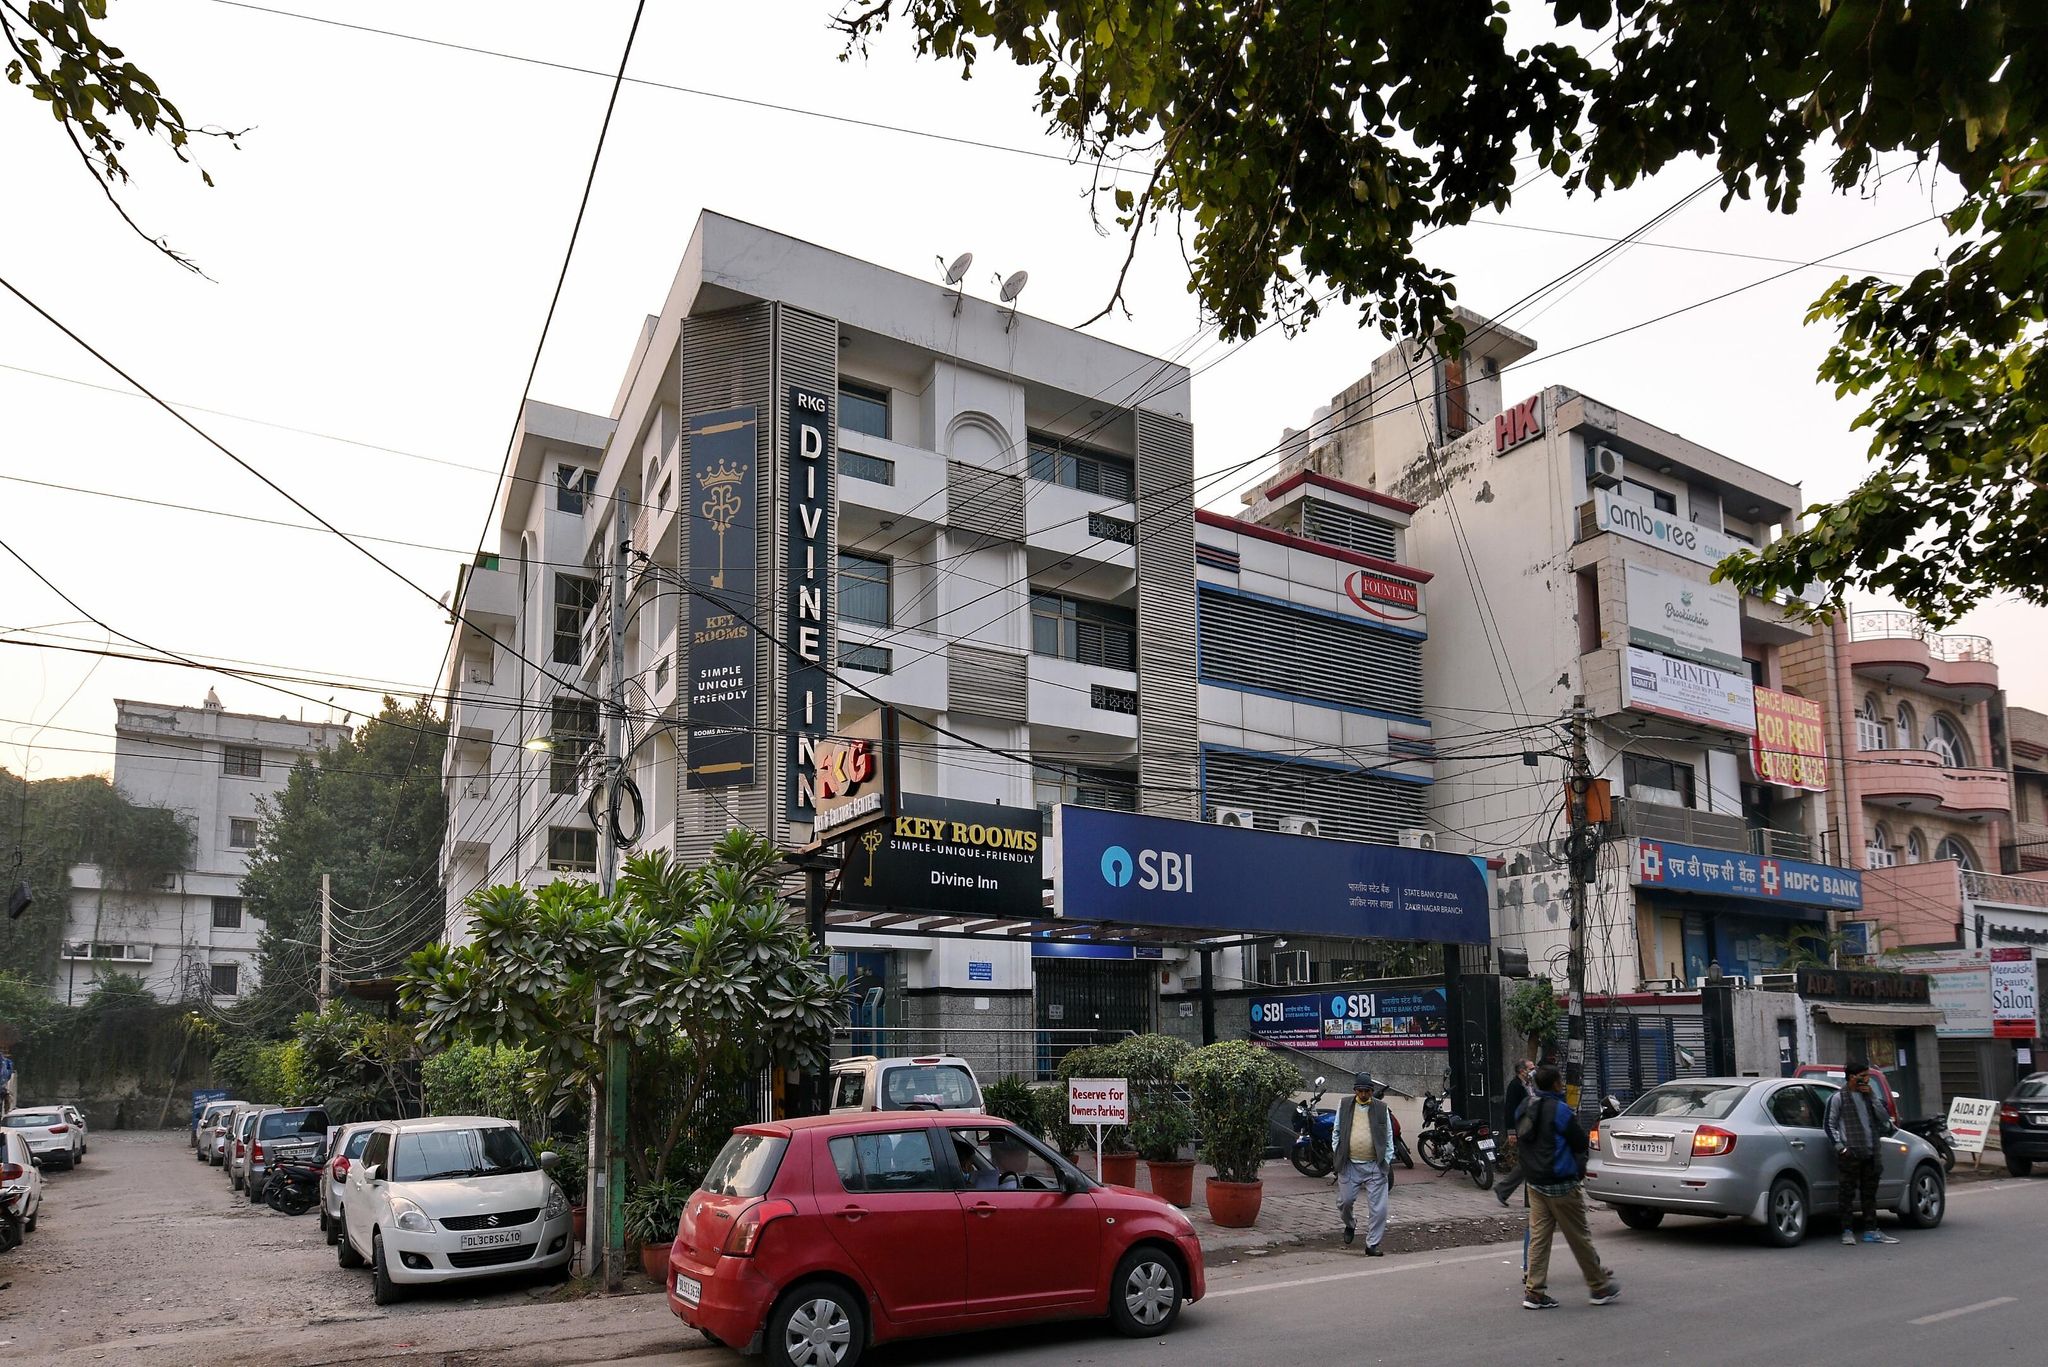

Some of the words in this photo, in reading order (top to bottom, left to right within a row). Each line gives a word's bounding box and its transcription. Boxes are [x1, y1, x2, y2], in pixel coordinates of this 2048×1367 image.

[798, 393, 826, 412] RKG
[1495, 395, 1540, 451] HK
[799, 424, 823, 663] DIVINE
[1364, 579, 1415, 602] FOUNTAIN
[706, 615, 735, 629] KEY
[694, 625, 748, 644] ROOMS
[701, 665, 741, 678] SIMPLE
[1662, 659, 1723, 689] TRINITY
[698, 678, 743, 691] UNIQUE
[693, 690, 748, 704] FRIENDLY
[1755, 687, 1780, 711] SPACE
[1782, 697, 1820, 721] AVAILABLE
[1757, 713, 1786, 746] FOR
[1788, 720, 1821, 753] RENT
[894, 816, 946, 841] KEY
[952, 822, 1038, 852] ROOMS
[930, 870, 974, 888] Divine
[977, 875, 998, 890] Inn
[1137, 848, 1194, 893] SBI
[1738, 860, 1756, 884] बैंक
[1404, 888, 1420, 897] STATE
[1421, 890, 1436, 899] BANK
[1436, 891, 1443, 899] OF
[1443, 892, 1458, 900] INDIA
[1784, 871, 1820, 892] HDFC
[1823, 877, 1859, 898] BANK
[1404, 903, 1421, 911] ZAKIR
[1422, 904, 1440, 913] NAGAR
[1440, 906, 1463, 915] BRANCH
[1996, 978, 2029, 988] Beauty
[1348, 994, 1376, 1017] SBI
[1993, 990, 2033, 1009] Salon
[1263, 1002, 1284, 1022] SBI
[1072, 1087, 1107, 1100] Reserve
[1108, 1088, 1124, 1100] for
[1071, 1104, 1097, 1116] Owners
[1098, 1105, 1125, 1120] Parking
[1953, 1102, 1975, 1116] AIDA
[1977, 1104, 1991, 1117] BY
